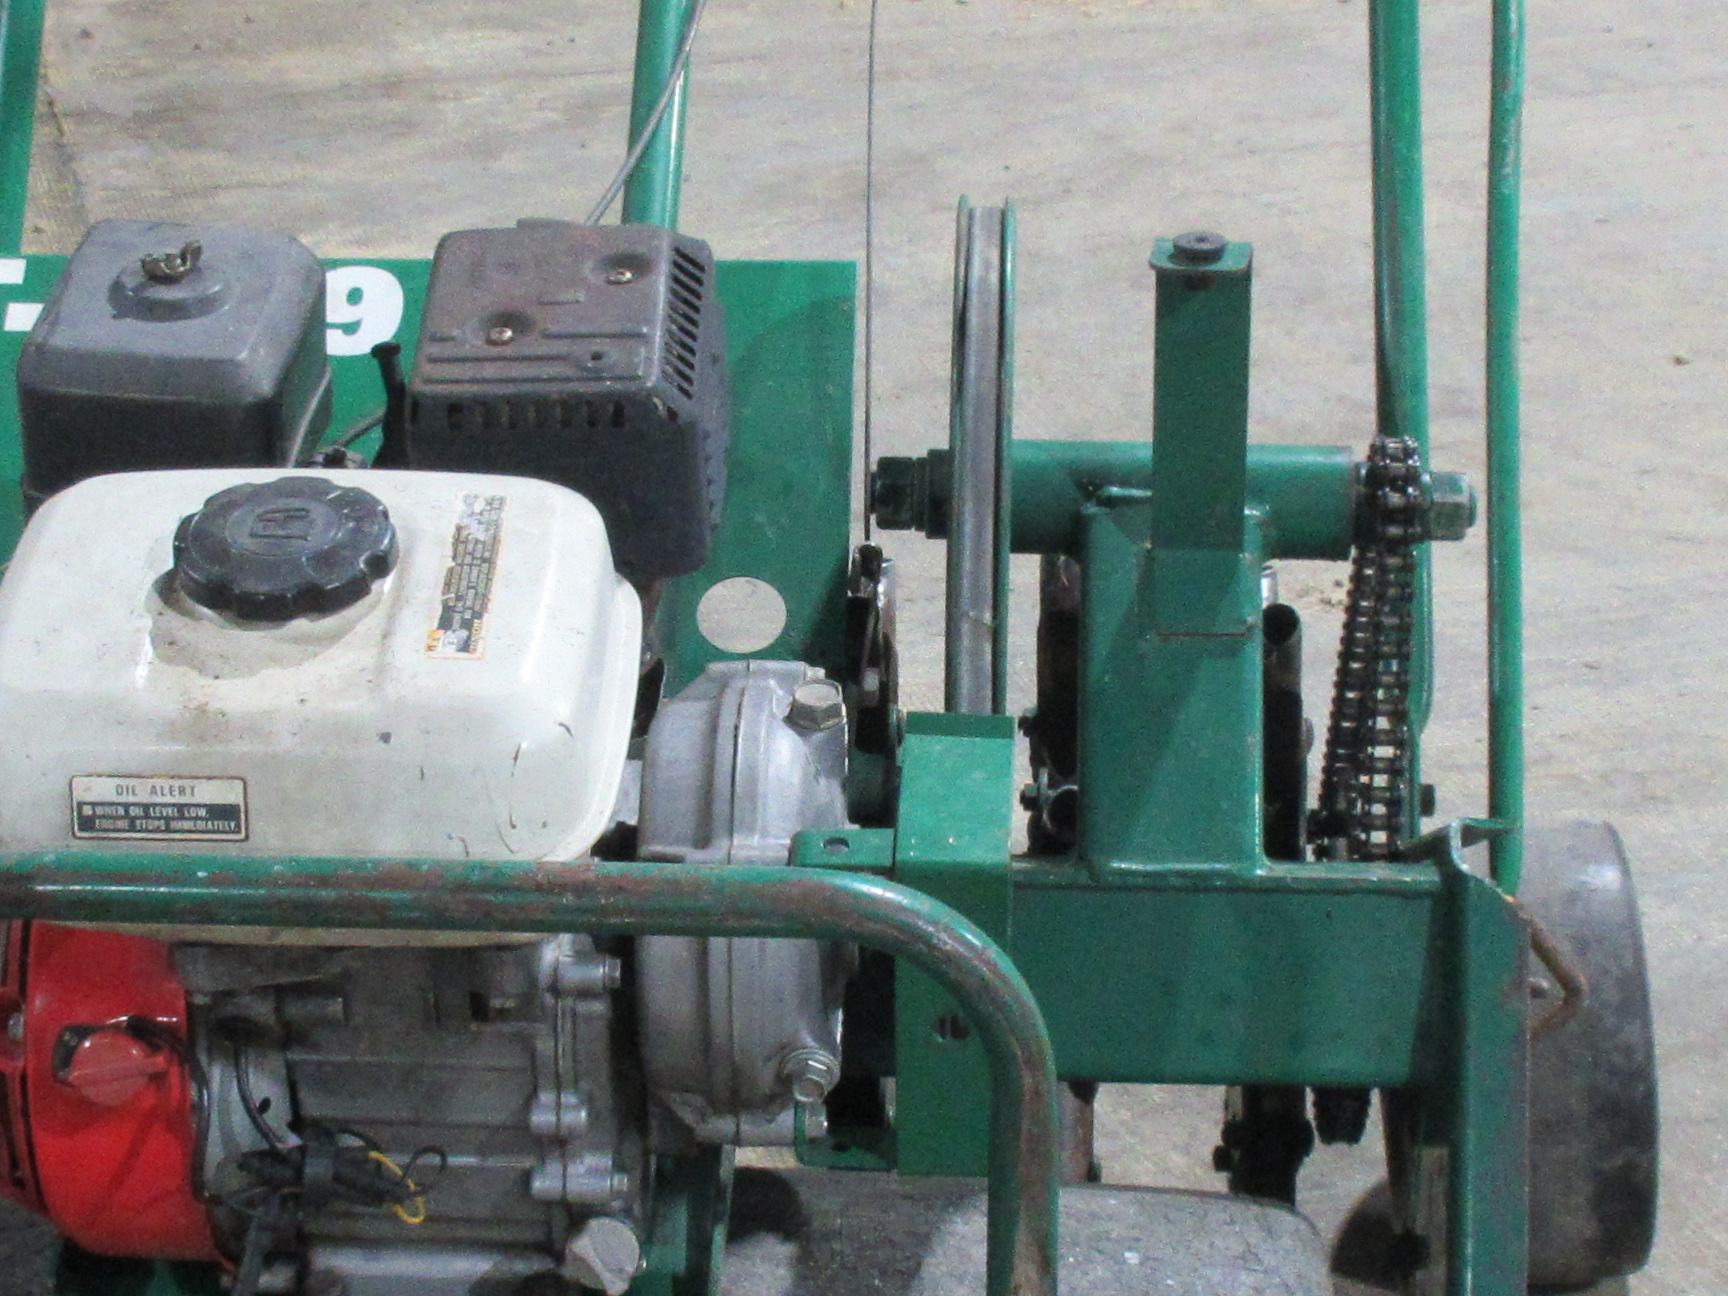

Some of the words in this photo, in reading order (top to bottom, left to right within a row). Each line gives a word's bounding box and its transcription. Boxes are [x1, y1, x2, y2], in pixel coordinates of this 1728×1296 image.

[115, 784, 138, 797] OIL
[149, 784, 197, 798] ALERT
[150, 807, 179, 817] LEVEL
